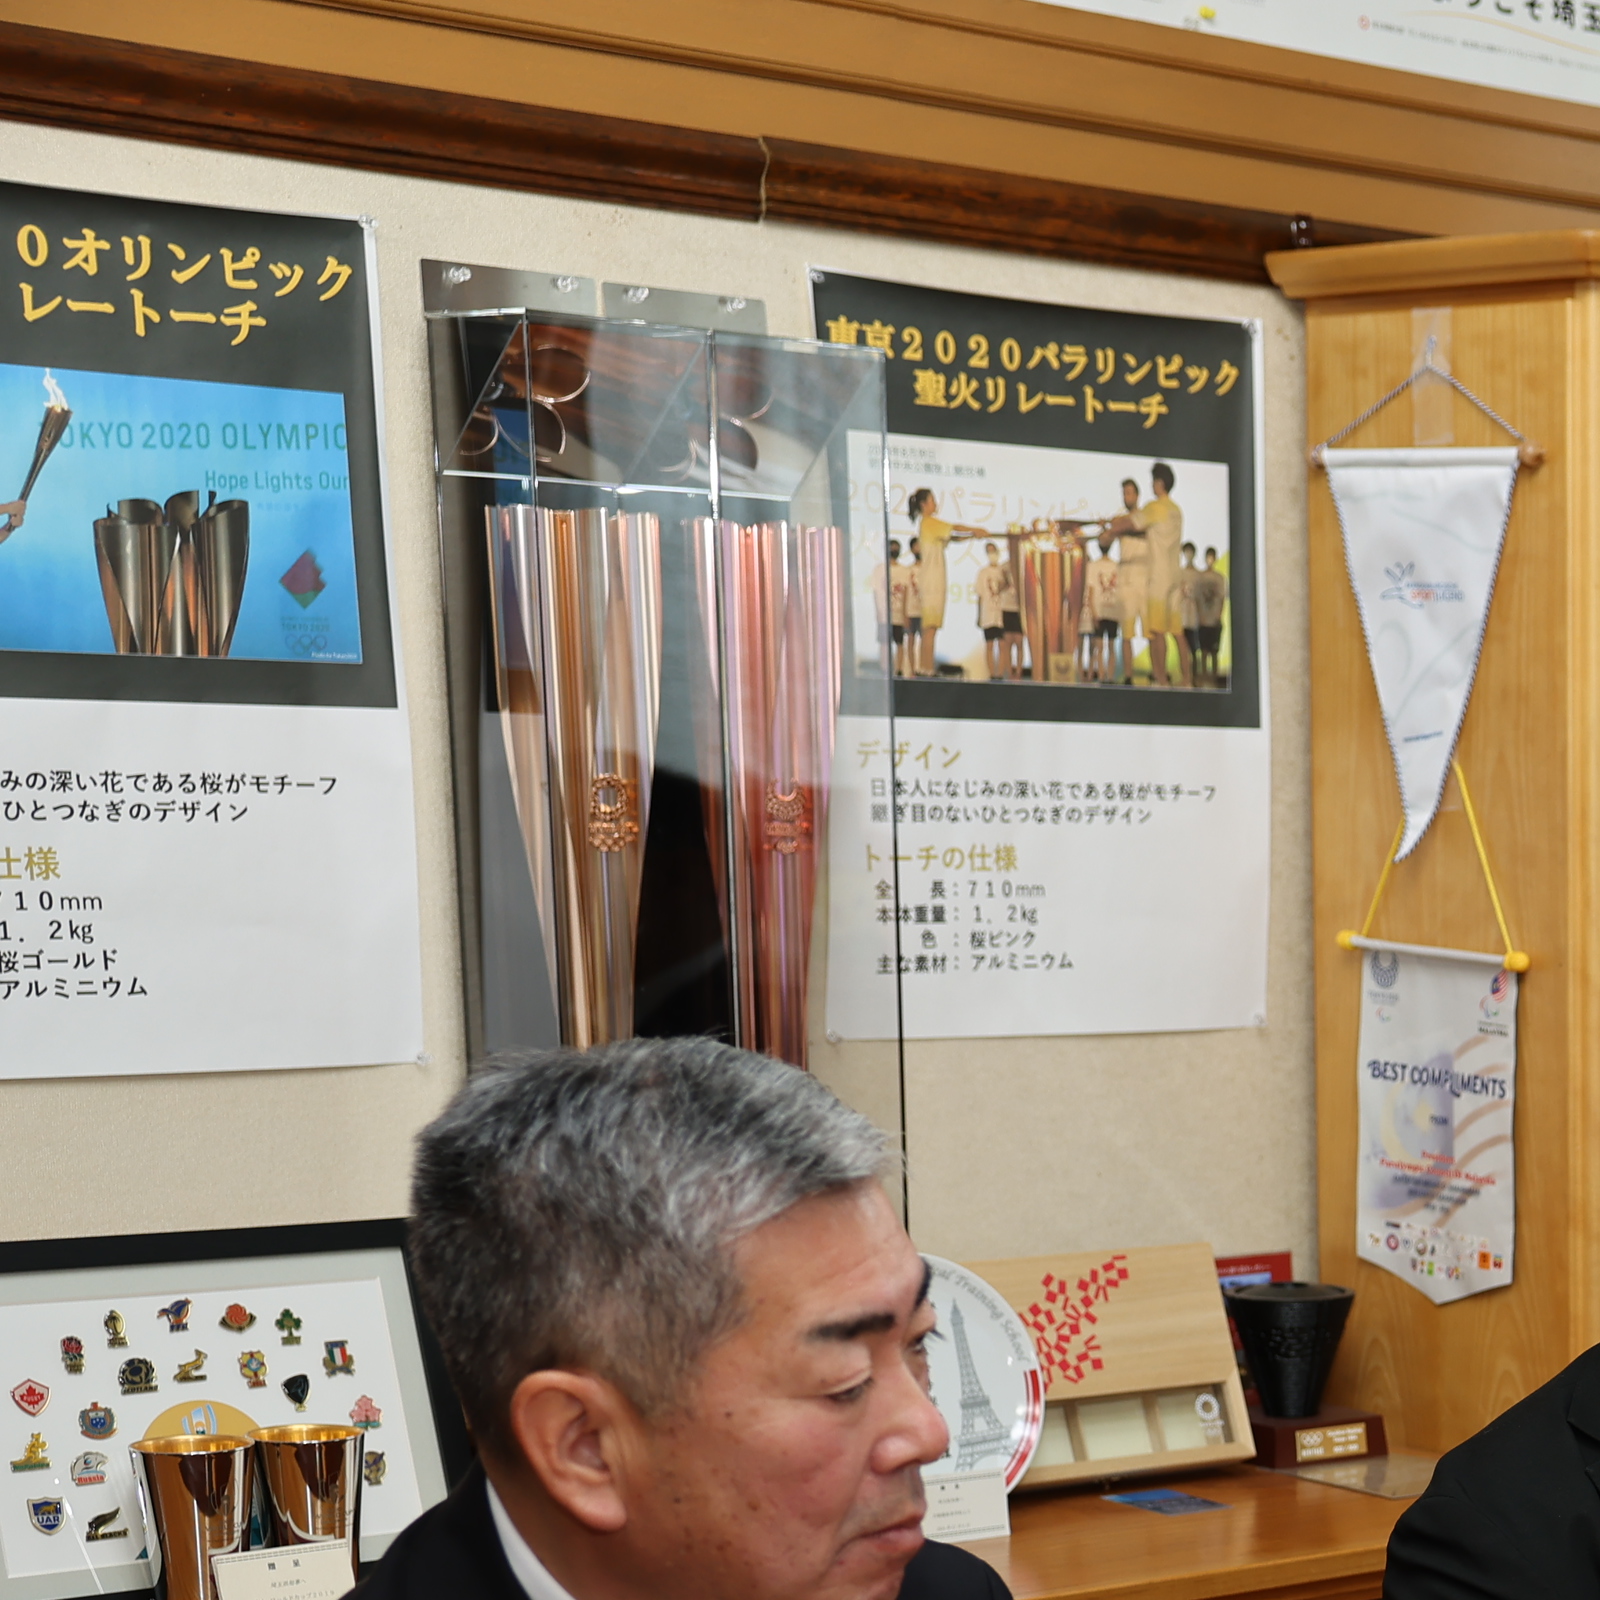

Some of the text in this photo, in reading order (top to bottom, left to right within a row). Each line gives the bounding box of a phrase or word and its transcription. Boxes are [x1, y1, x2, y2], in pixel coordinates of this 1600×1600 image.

[19, 282, 268, 346] レートーチ
[913, 368, 1169, 429] 聖火リレートーチ
[141, 422, 211, 450] 2020
[205, 469, 349, 493] Hope Lights Our
[857, 739, 962, 770] デザイン
[0, 770, 338, 796] みの深い花である桜がモチーフ
[870, 777, 1217, 803] 日本人になじみの深い花である桜がモチーフ
[3, 799, 249, 824] ひとつなぎのデザイン
[864, 842, 1018, 874] トーチの仕様
[0, 977, 149, 1000] アルミニウム
[1367, 1058, 1507, 1099] BEST COMPLIMENTS
[77, 1474, 105, 1484] Russia
[36, 1514, 61, 1526] UAR
